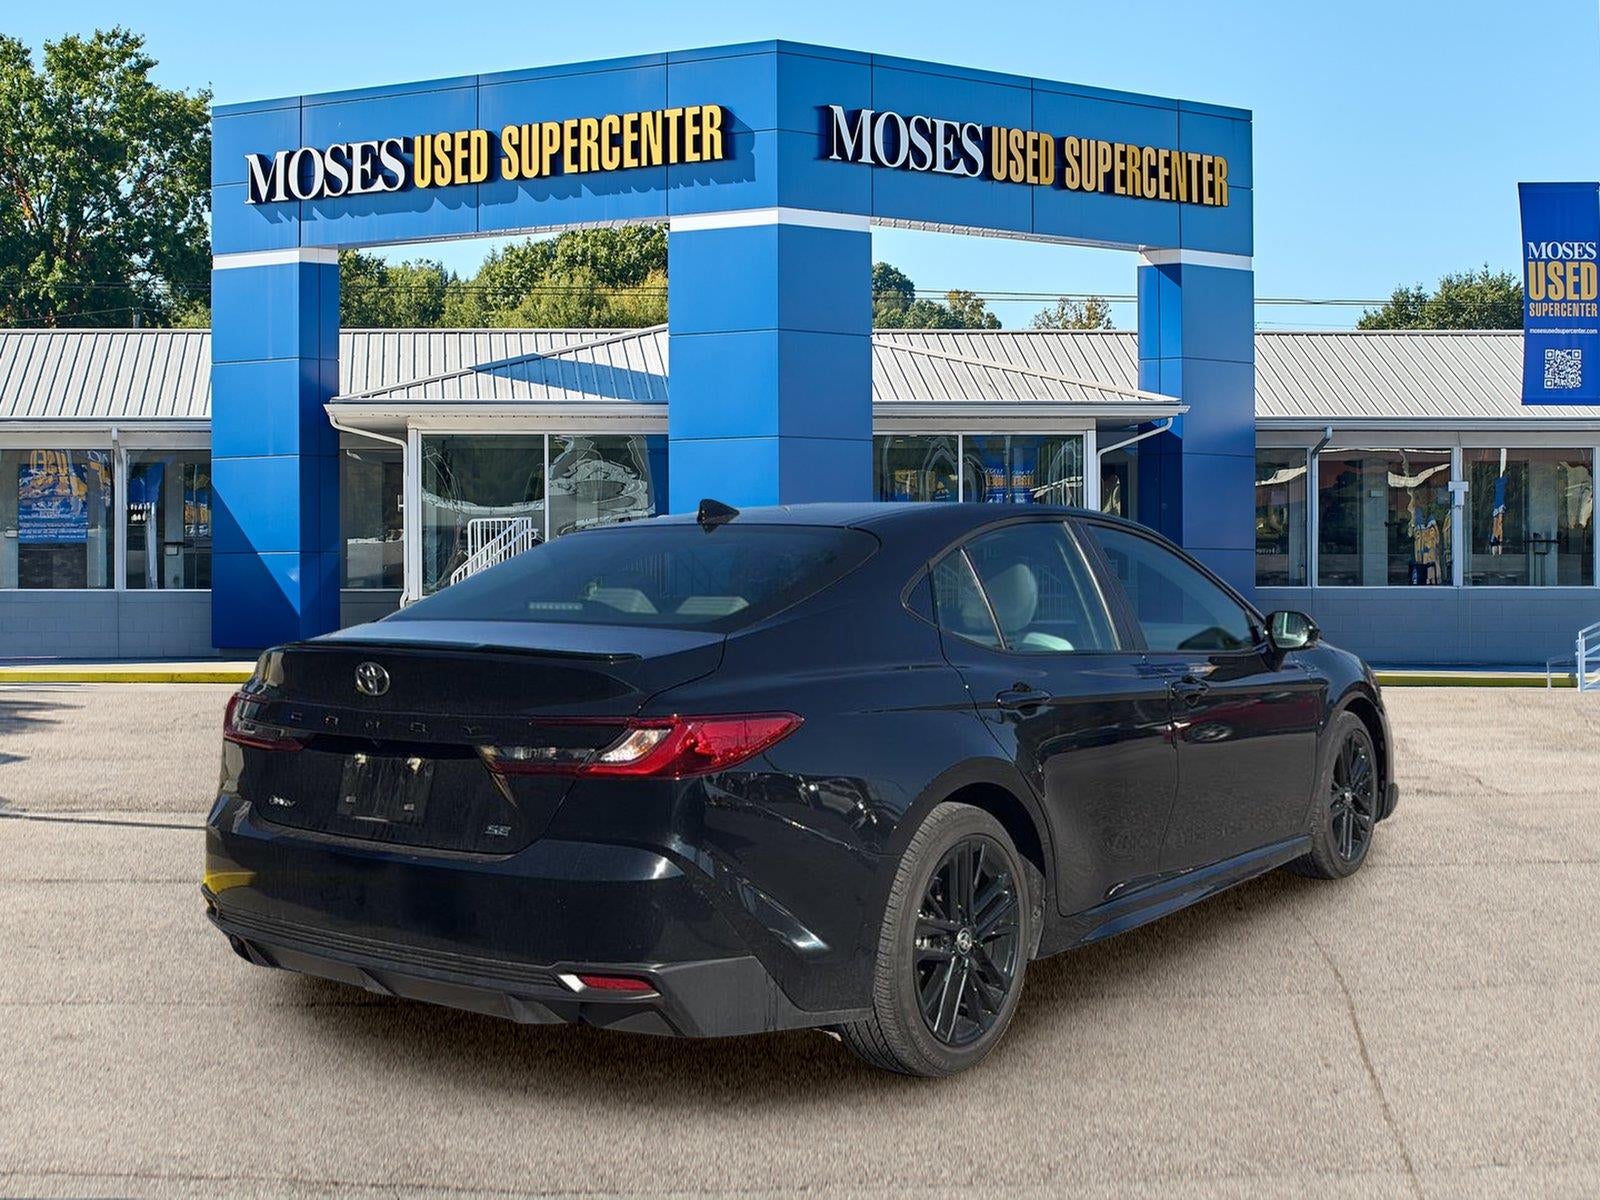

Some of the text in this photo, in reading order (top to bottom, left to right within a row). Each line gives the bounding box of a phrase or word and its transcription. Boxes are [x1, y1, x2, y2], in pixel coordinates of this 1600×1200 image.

[244, 104, 725, 205] MOSES USED SUPERCENTER
[828, 104, 1230, 207] MOSES USED SUPERCENTER
[1527, 241, 1597, 260] MOSES
[1527, 261, 1598, 301] USED
[1529, 302, 1598, 317] SUPERCENTER
[1529, 327, 1598, 335] mosesusedsupercenter.com
